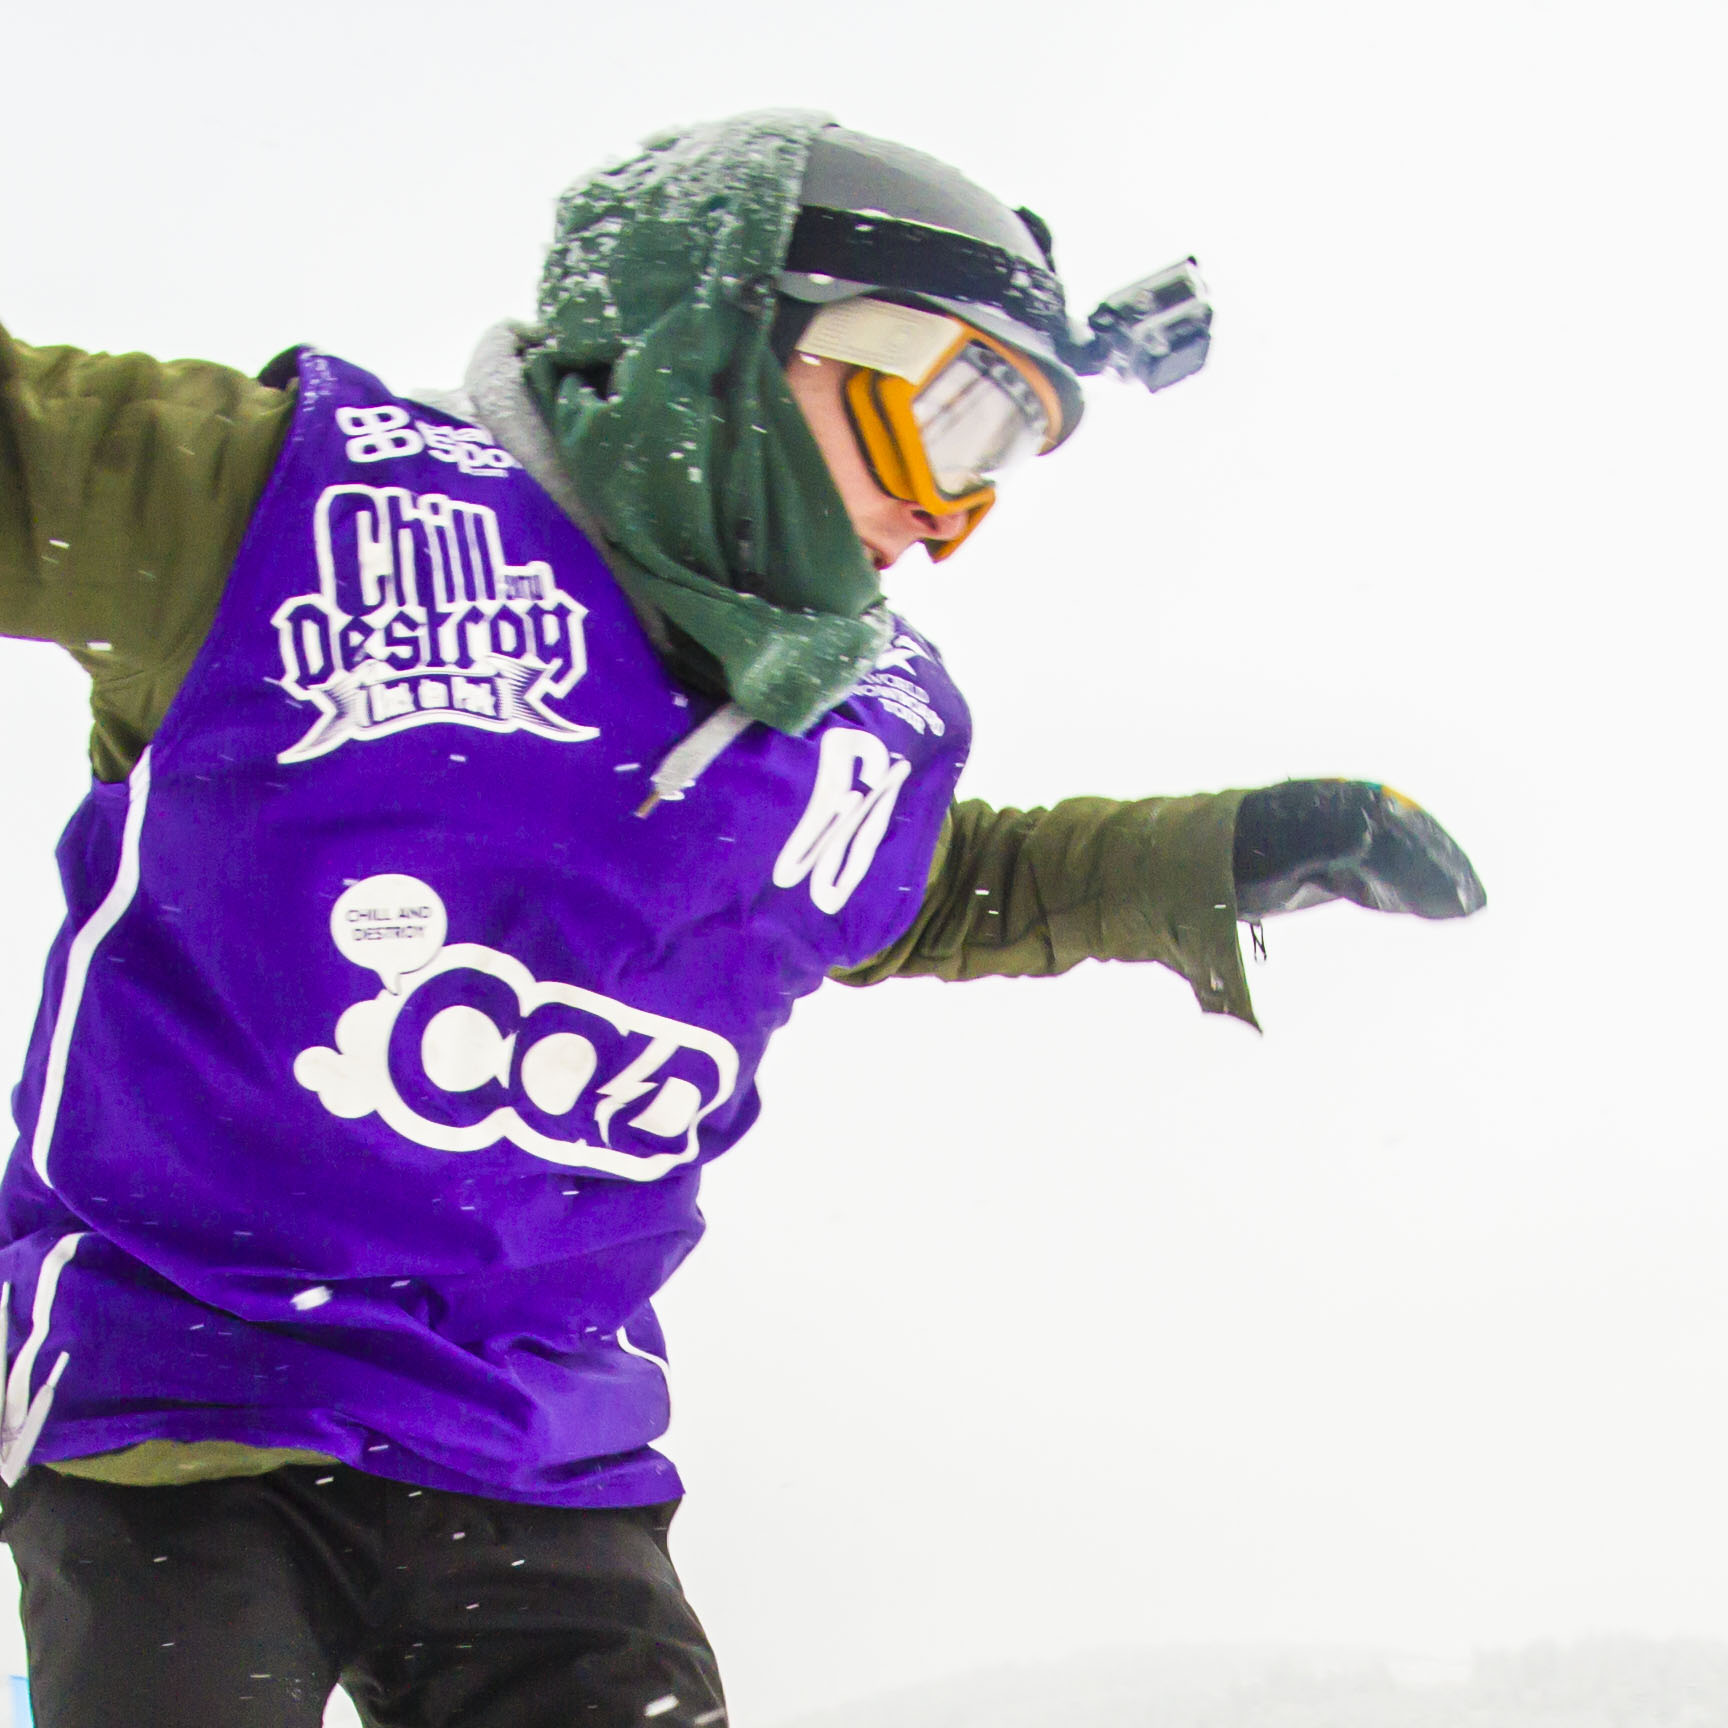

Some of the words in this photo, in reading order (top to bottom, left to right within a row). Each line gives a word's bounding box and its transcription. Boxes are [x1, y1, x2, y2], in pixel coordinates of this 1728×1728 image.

[322, 487, 501, 618] Chill
[282, 597, 581, 694] Destroy
[346, 908, 391, 923] CHILL
[399, 905, 431, 919] AND
[353, 925, 425, 942] DESTROY
